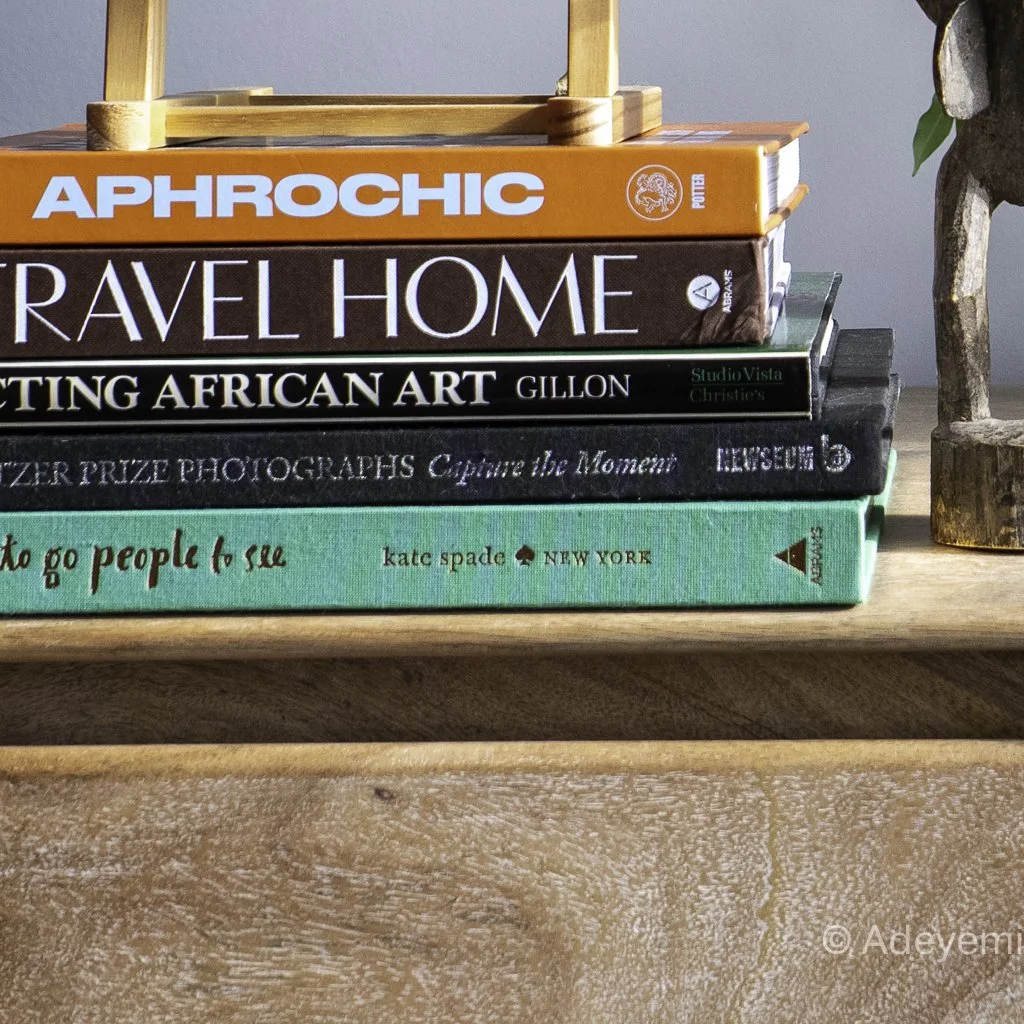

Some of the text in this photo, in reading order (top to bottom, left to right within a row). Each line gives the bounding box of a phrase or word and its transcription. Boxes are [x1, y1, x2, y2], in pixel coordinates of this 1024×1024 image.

[32, 171, 545, 219] APHROCHIC
[691, 173, 705, 209] POTTER
[0, 253, 638, 344] RAVEL HOME
[722, 269, 733, 313] ABRAMS
[151, 371, 381, 410] AFRICAN
[393, 370, 496, 407] ART
[516, 374, 631, 401] GILLON
[691, 367, 782, 382] Studio Vista
[690, 387, 765, 402] Christie's
[79, 458, 169, 486] PRIZE
[177, 454, 415, 484] PHOTOGRAPHS
[428, 453, 525, 486] Capture
[531, 450, 568, 477] the
[575, 449, 678, 476] Moment
[716, 445, 814, 473] NEWSEUM
[0, 528, 287, 595] to go people to see
[382, 545, 652, 574] kate spade NEW YORK
[810, 526, 823, 586] ABRAMS
